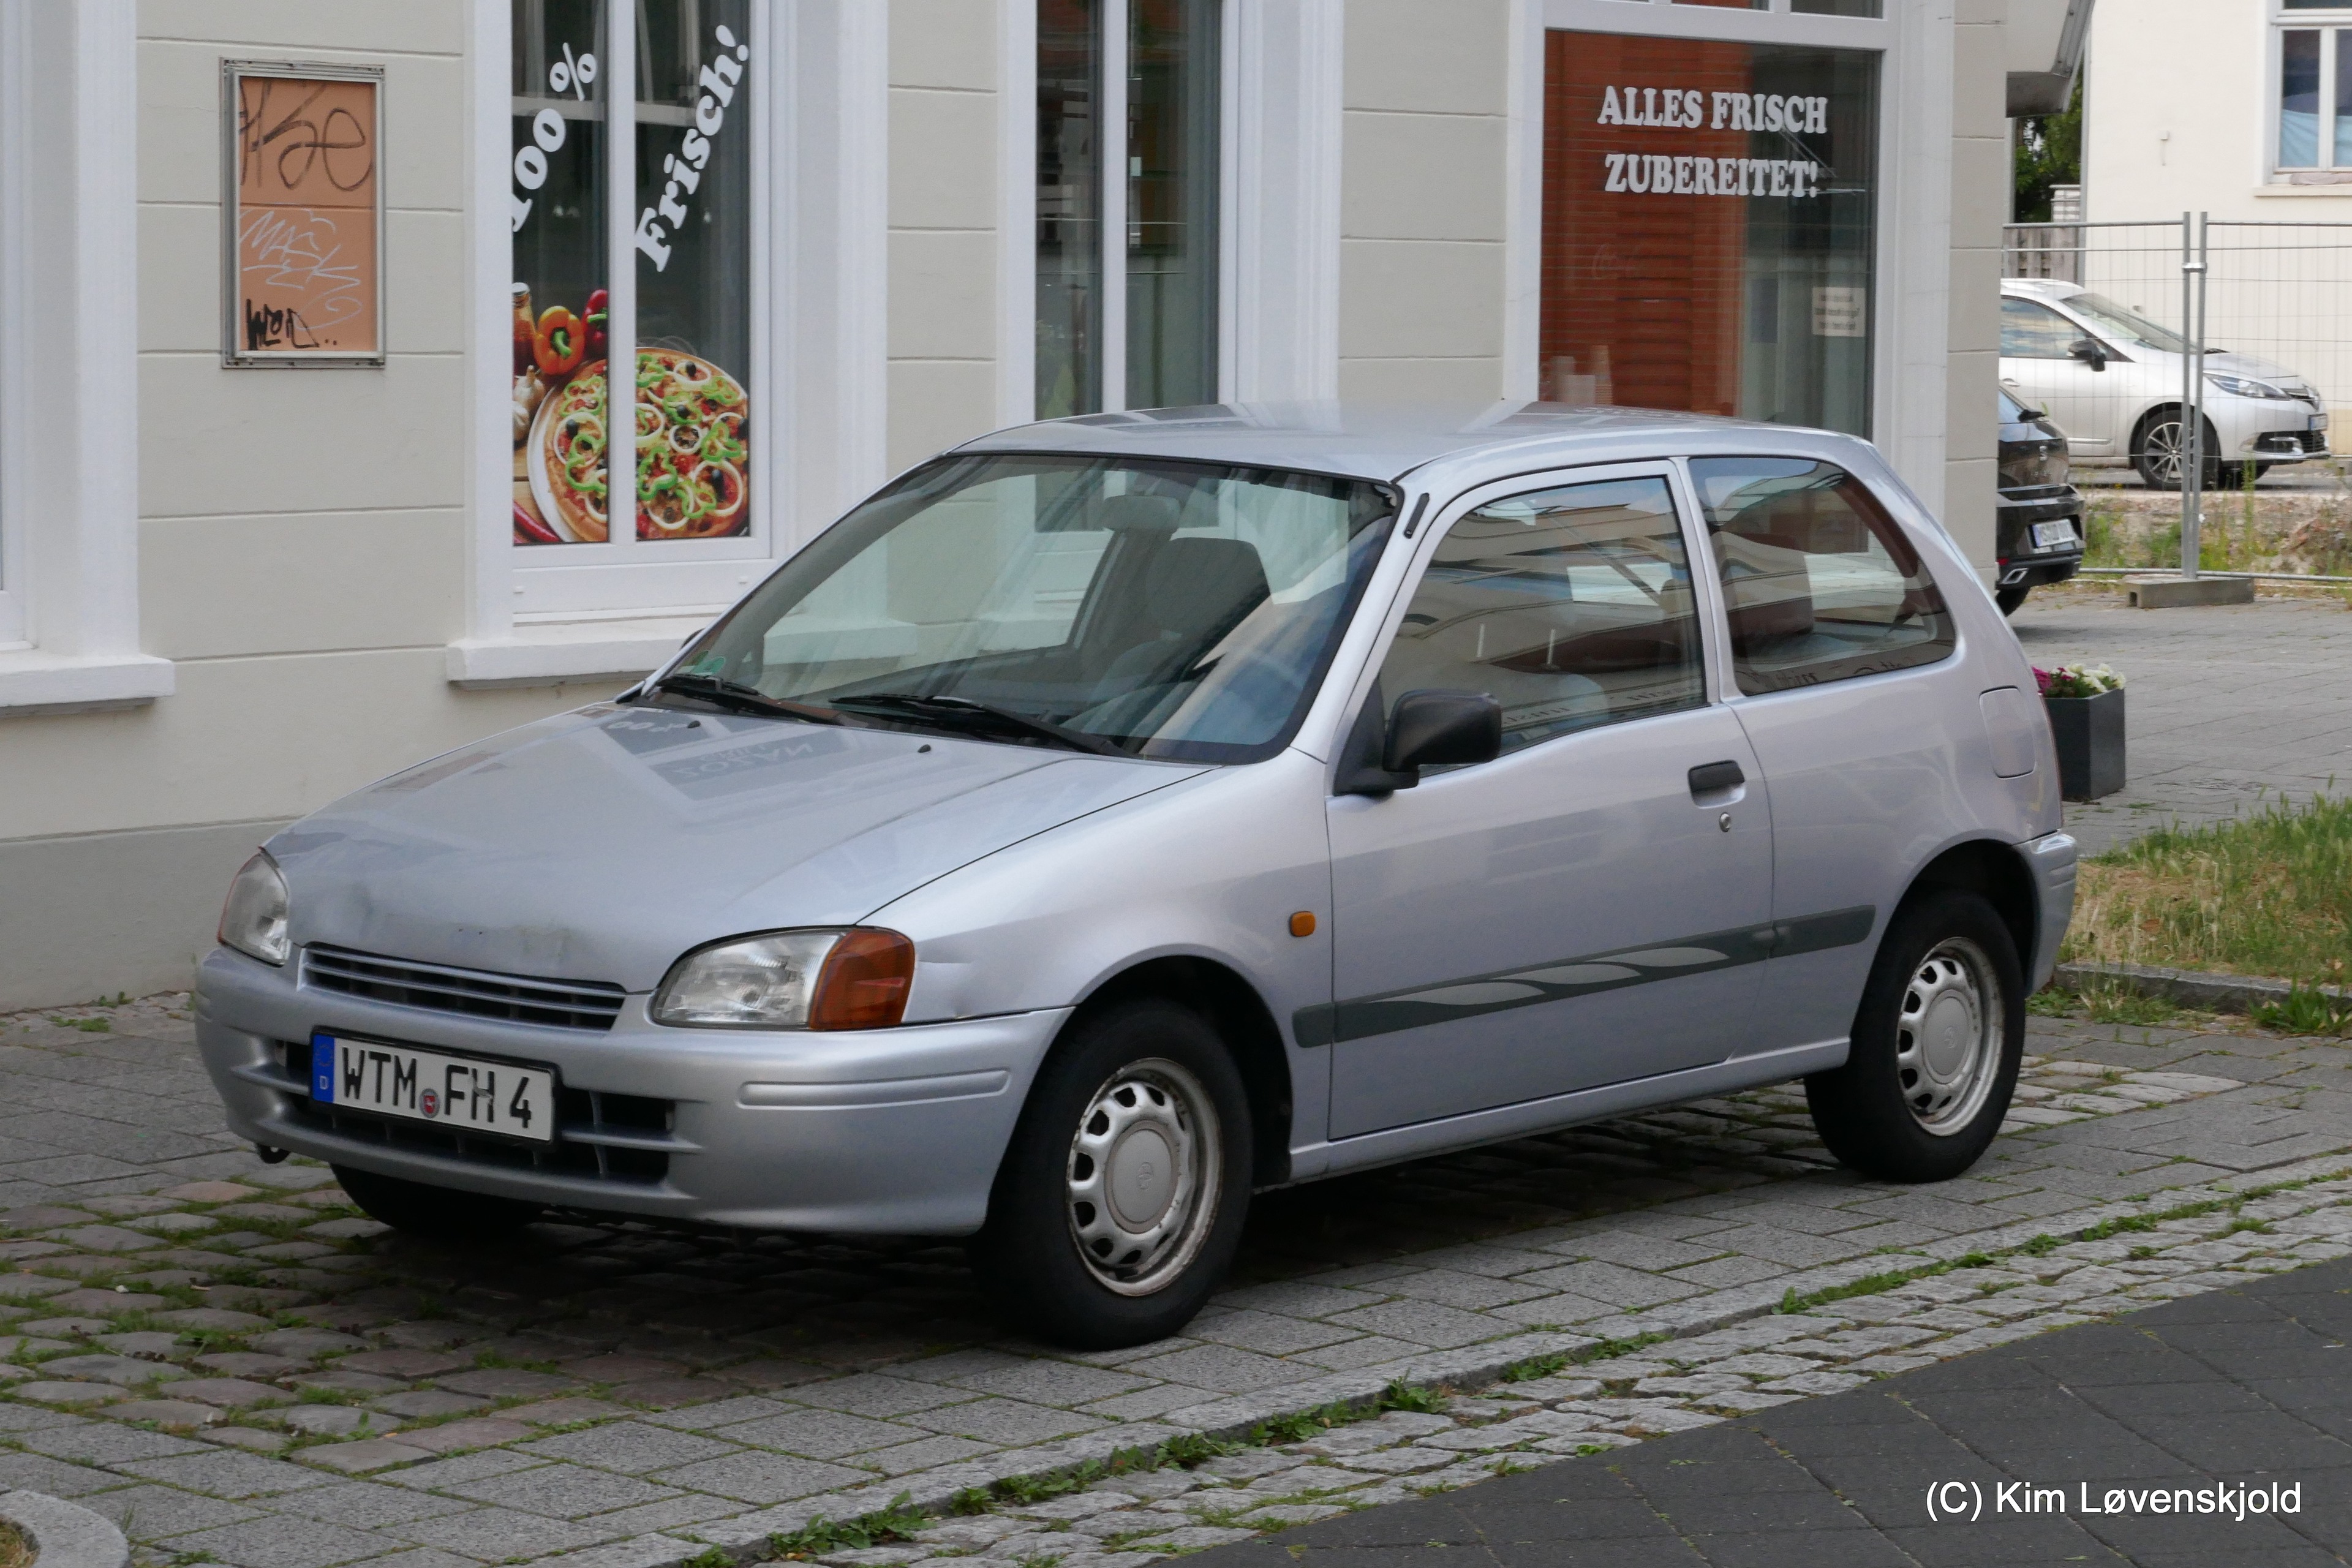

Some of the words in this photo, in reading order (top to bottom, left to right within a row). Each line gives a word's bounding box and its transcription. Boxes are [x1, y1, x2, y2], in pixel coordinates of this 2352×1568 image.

[549, 42, 598, 101] %
[1597, 85, 1703, 129] ALLES
[1710, 91, 1828, 134] FRISCH
[635, 24, 749, 273] Frisch!
[1605, 153, 1819, 198] ZUBEREITET!
[319, 1075, 329, 1090] D
[342, 1047, 417, 1109] WTM
[443, 1064, 496, 1123] FH
[509, 1076, 532, 1129] 4
